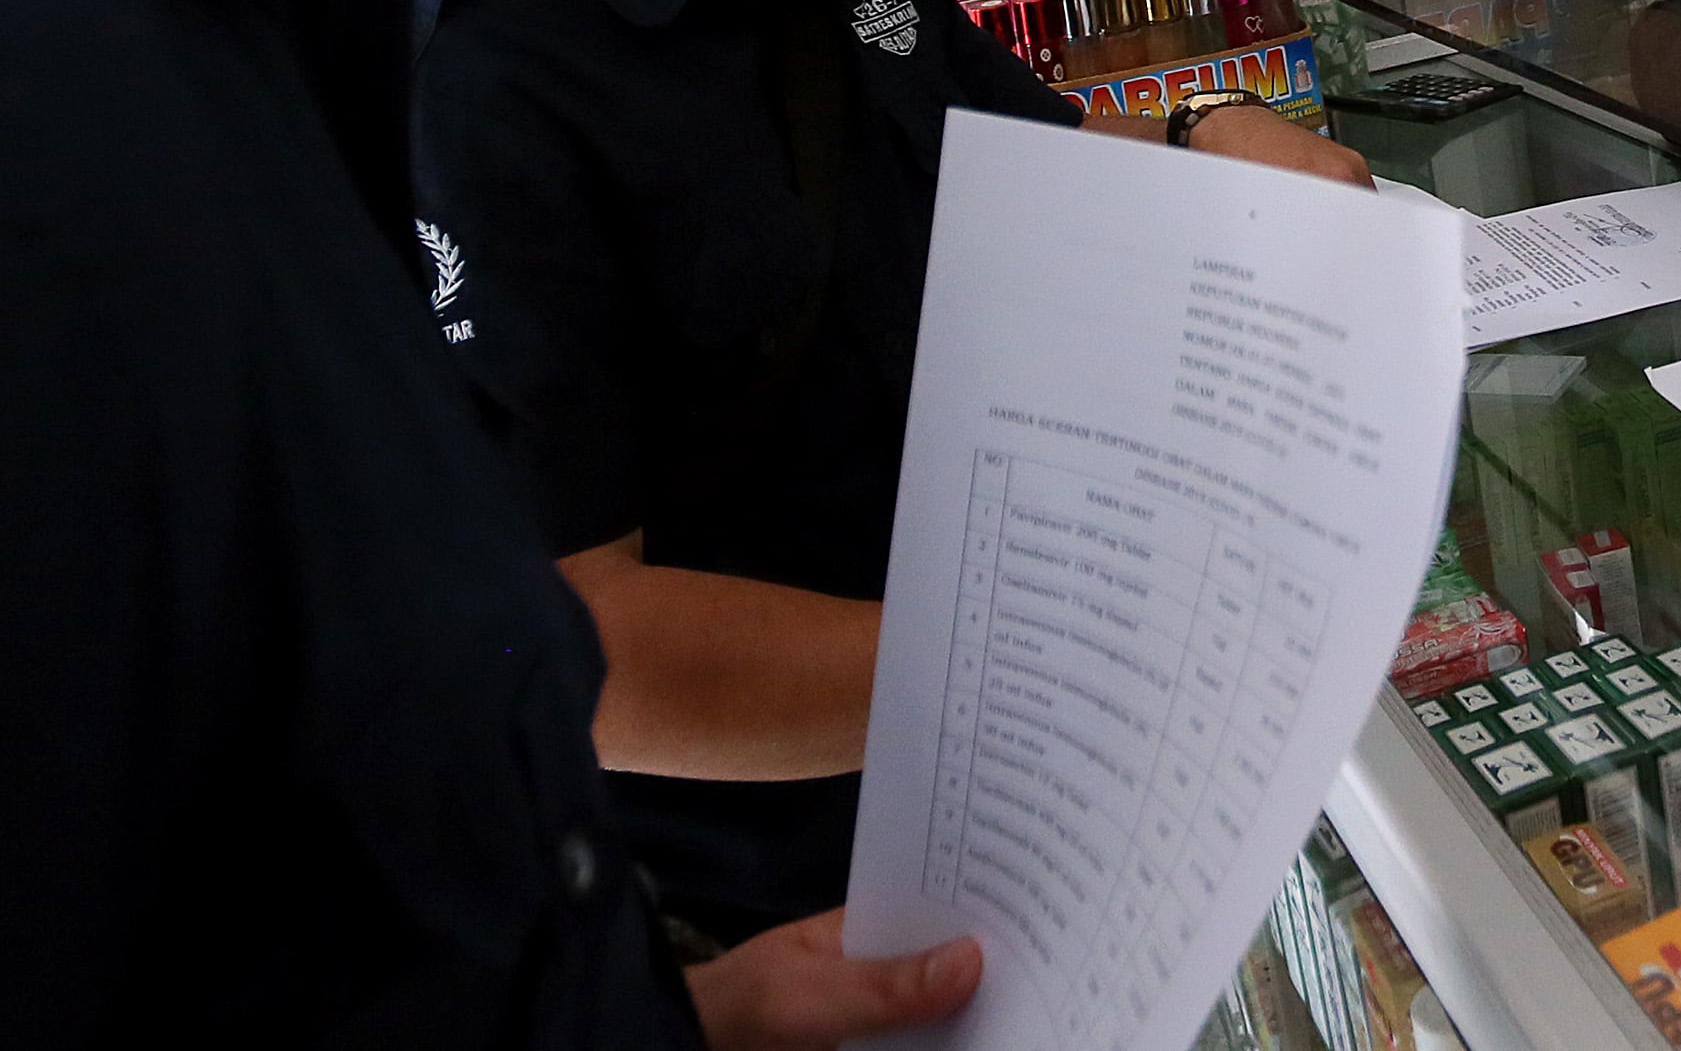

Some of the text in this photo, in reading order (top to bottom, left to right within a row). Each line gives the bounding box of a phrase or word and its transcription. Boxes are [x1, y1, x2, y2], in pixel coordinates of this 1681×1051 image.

[1060, 45, 1291, 118] ARFUM
[442, 319, 475, 344] TAR
[1551, 837, 1606, 889] GPU
